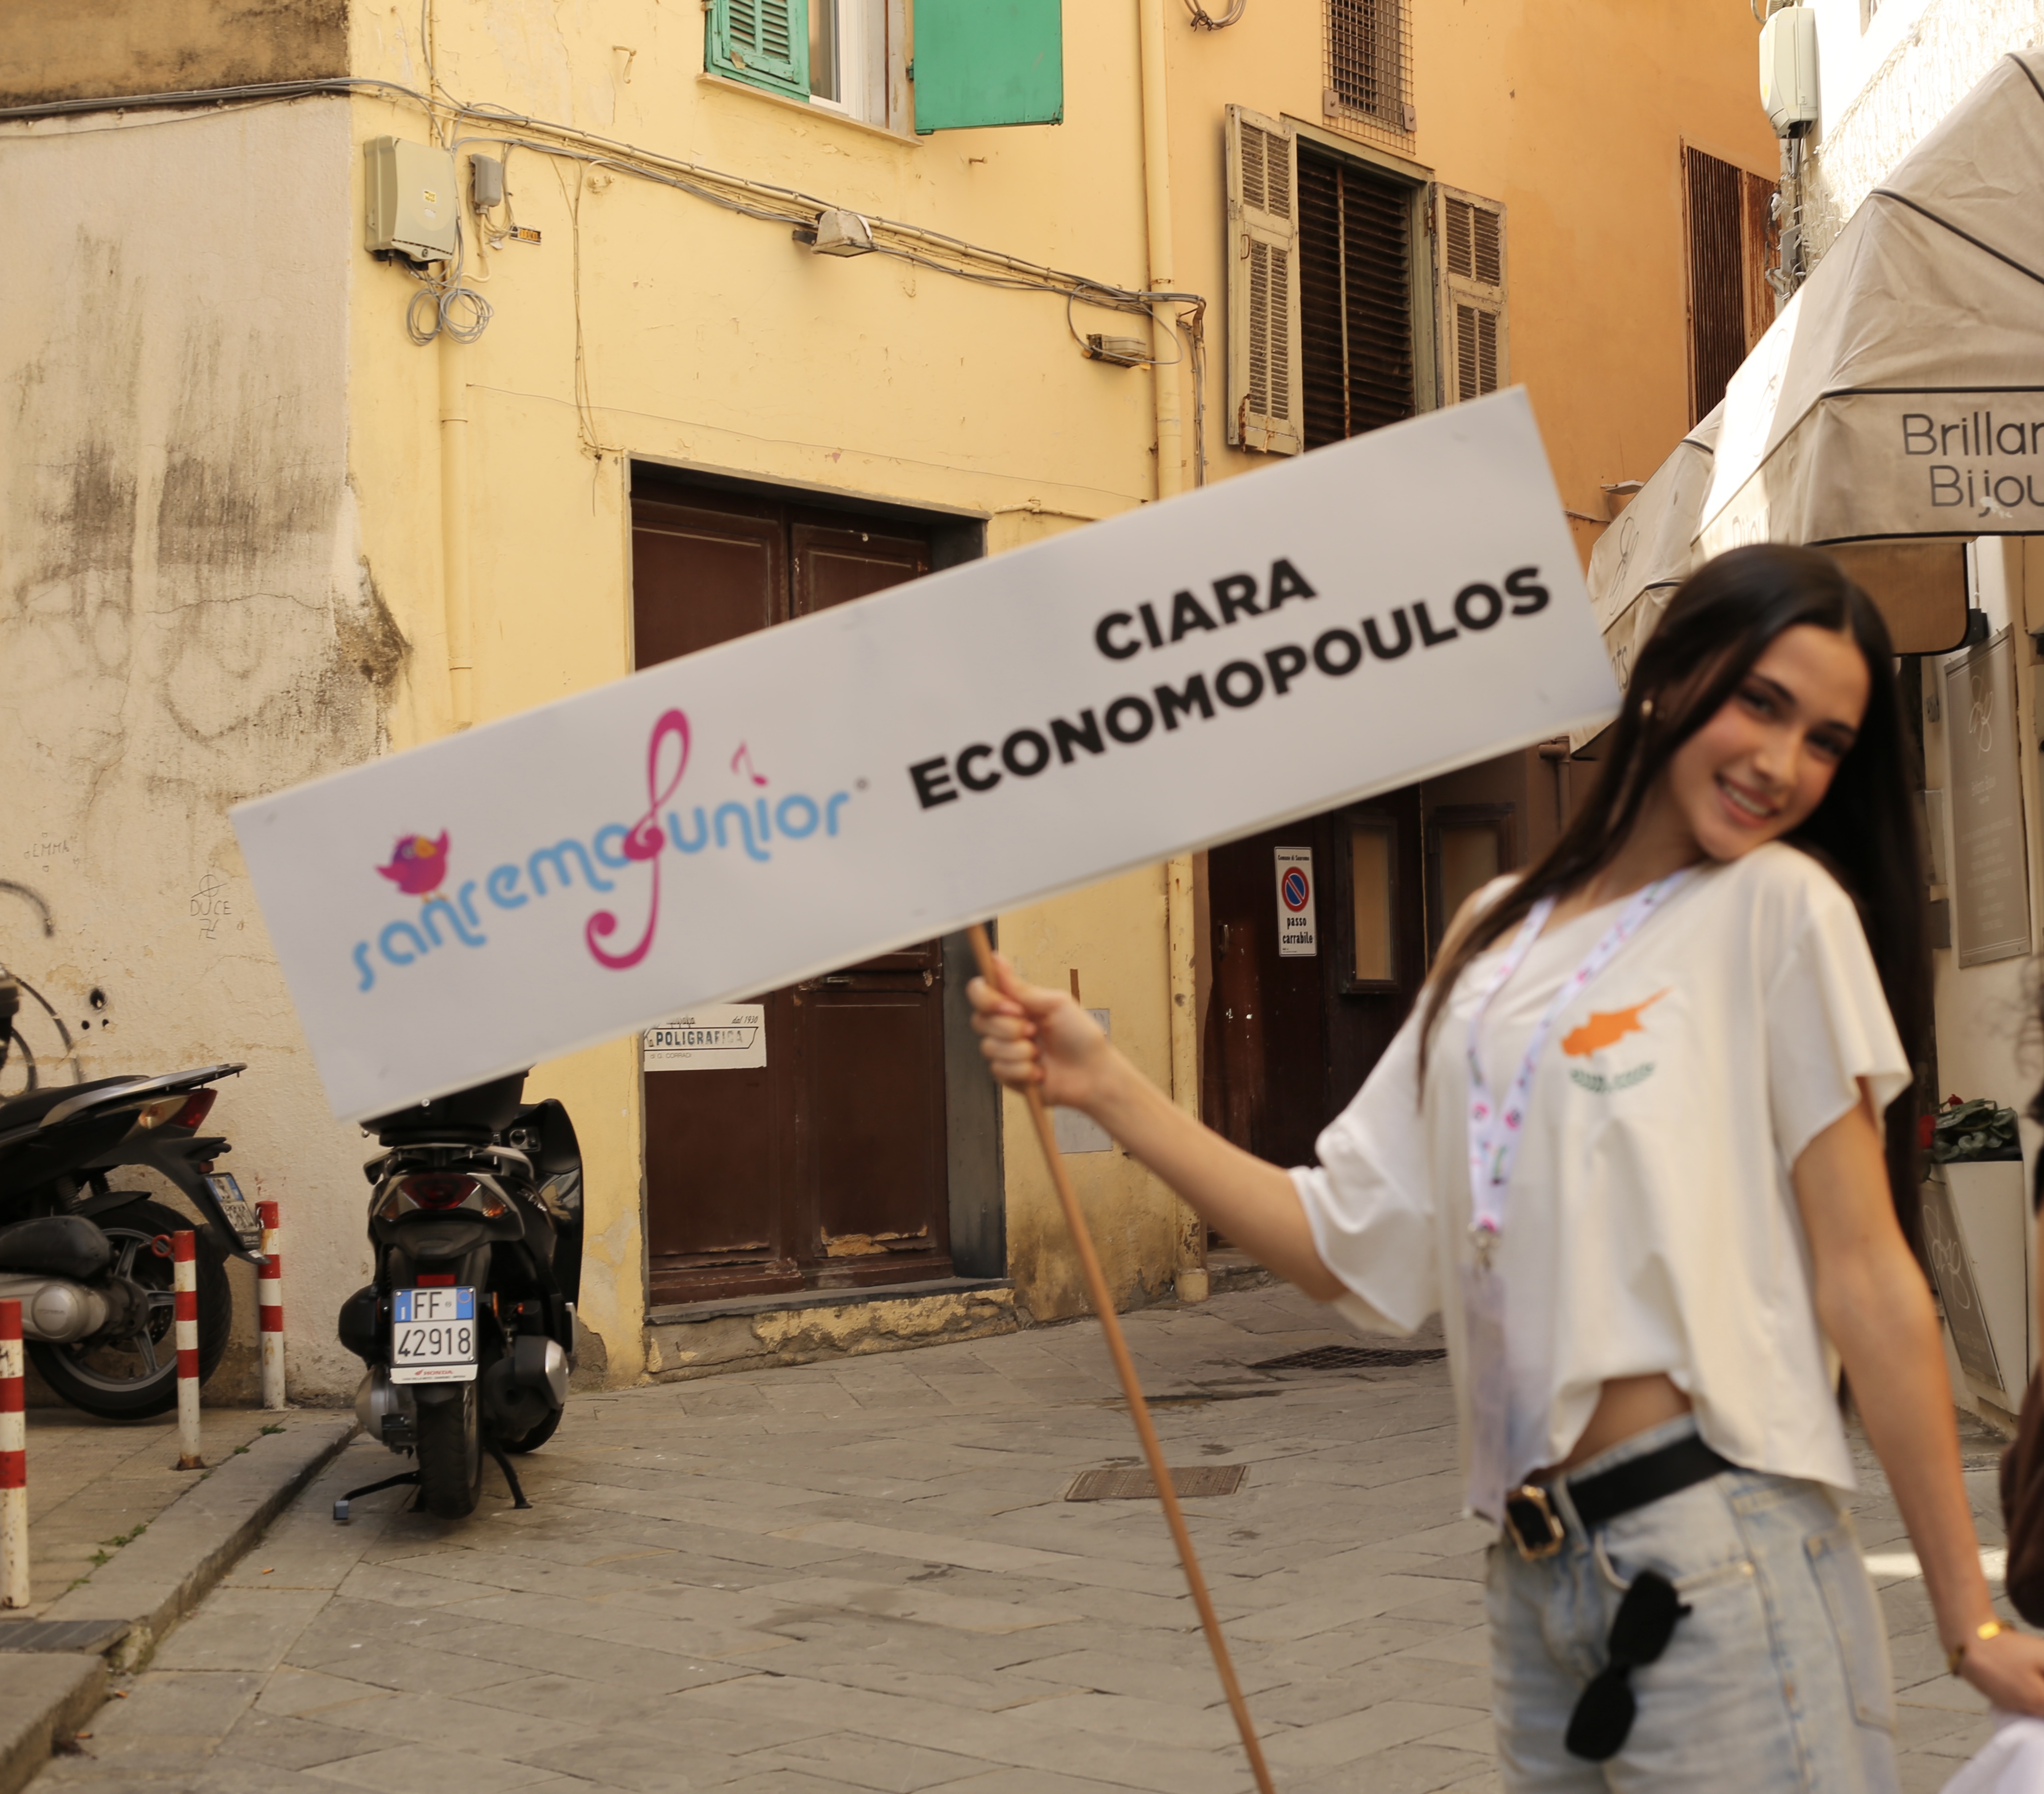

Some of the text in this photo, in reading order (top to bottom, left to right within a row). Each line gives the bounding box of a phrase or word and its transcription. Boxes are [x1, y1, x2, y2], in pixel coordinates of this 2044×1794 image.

[1093, 557, 1319, 661] CIARA
[908, 566, 1551, 809] ECONOMOPOULOS
[190, 898, 232, 916] DUCE
[1287, 917, 1306, 929] passo
[1282, 931, 1313, 944] carrabile
[732, 1016, 758, 1024] dal 1930
[415, 1291, 442, 1319] FF
[398, 1327, 471, 1357] 42918
